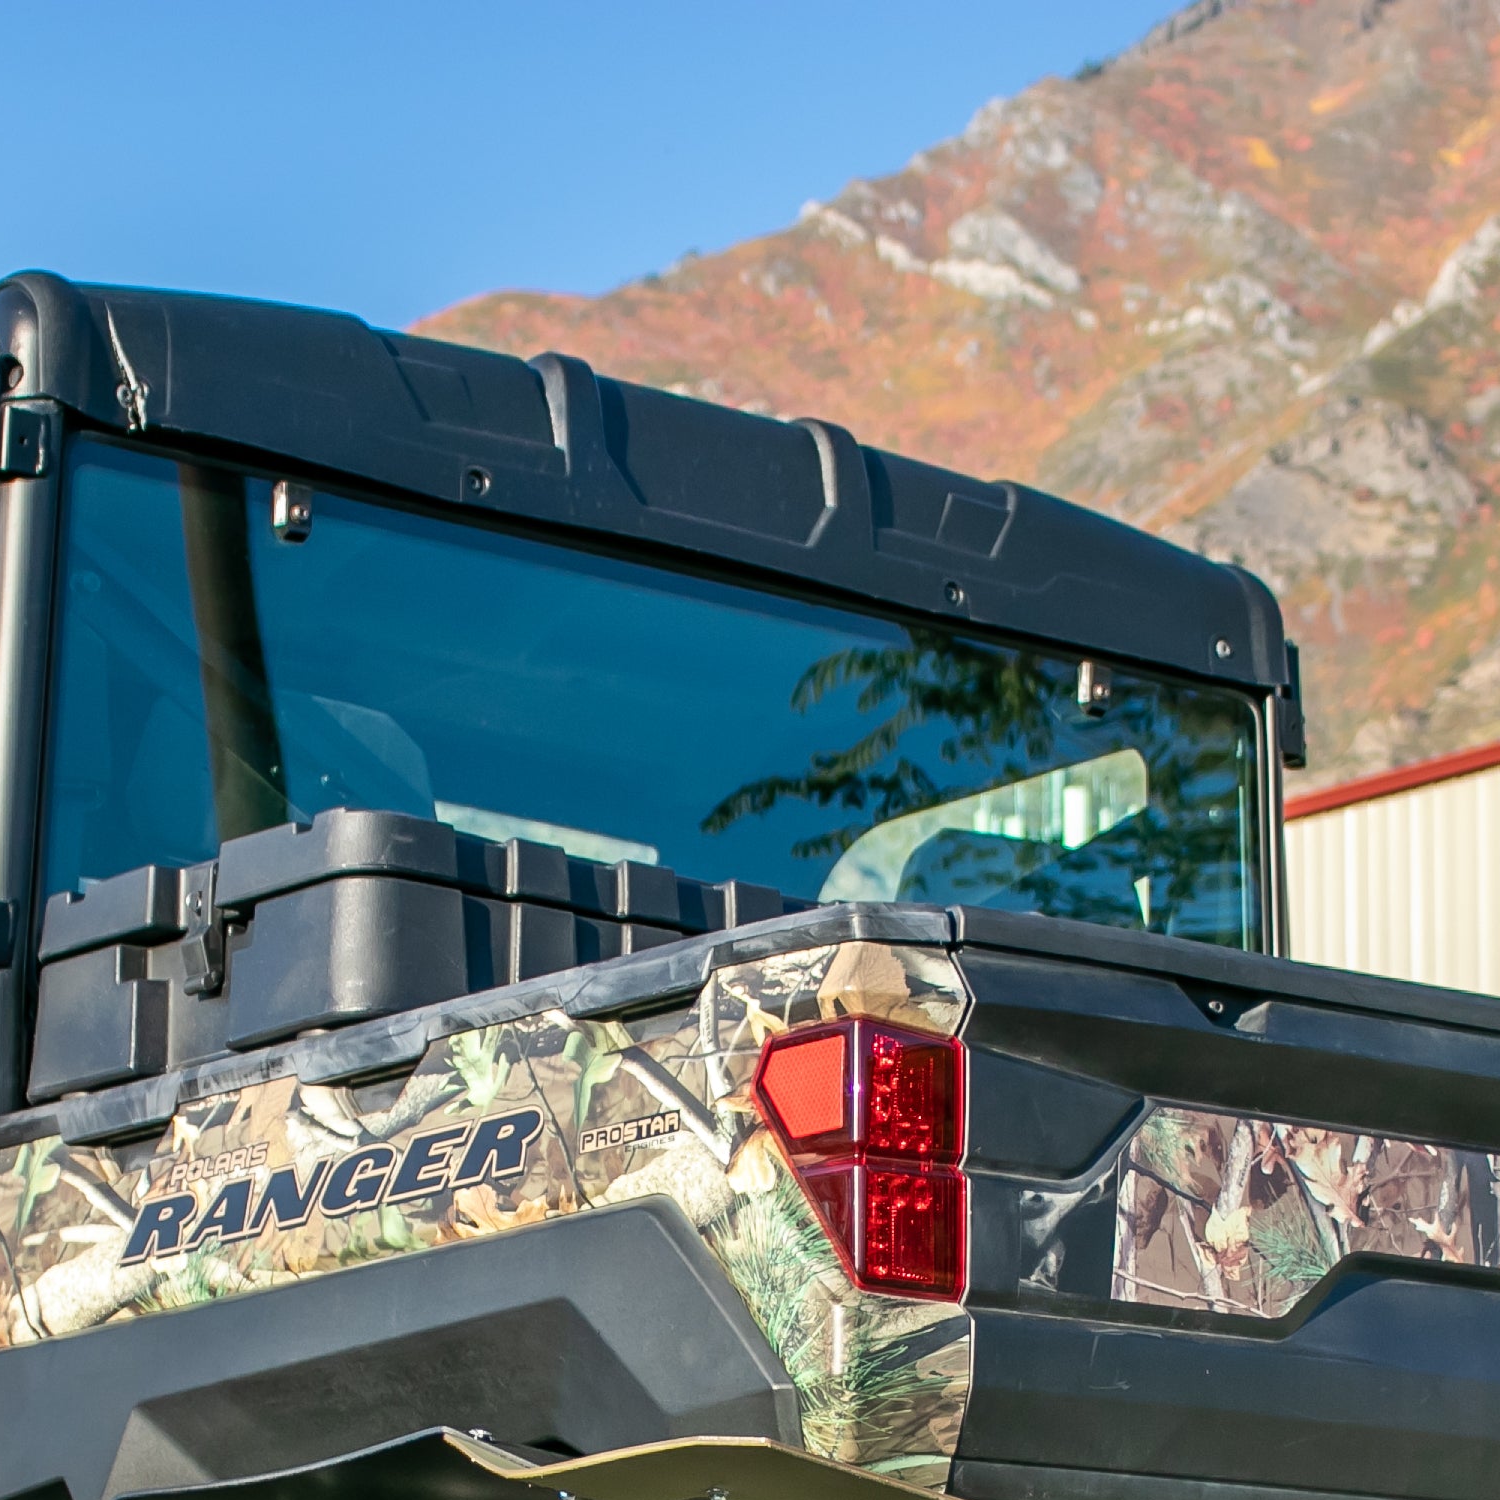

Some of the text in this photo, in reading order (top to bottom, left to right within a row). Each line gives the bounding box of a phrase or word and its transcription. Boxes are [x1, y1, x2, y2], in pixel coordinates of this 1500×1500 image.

[581, 1111, 679, 1152] PROSTAR
[119, 1105, 544, 1267] RANGER
[169, 1141, 269, 1189] POLARIS
